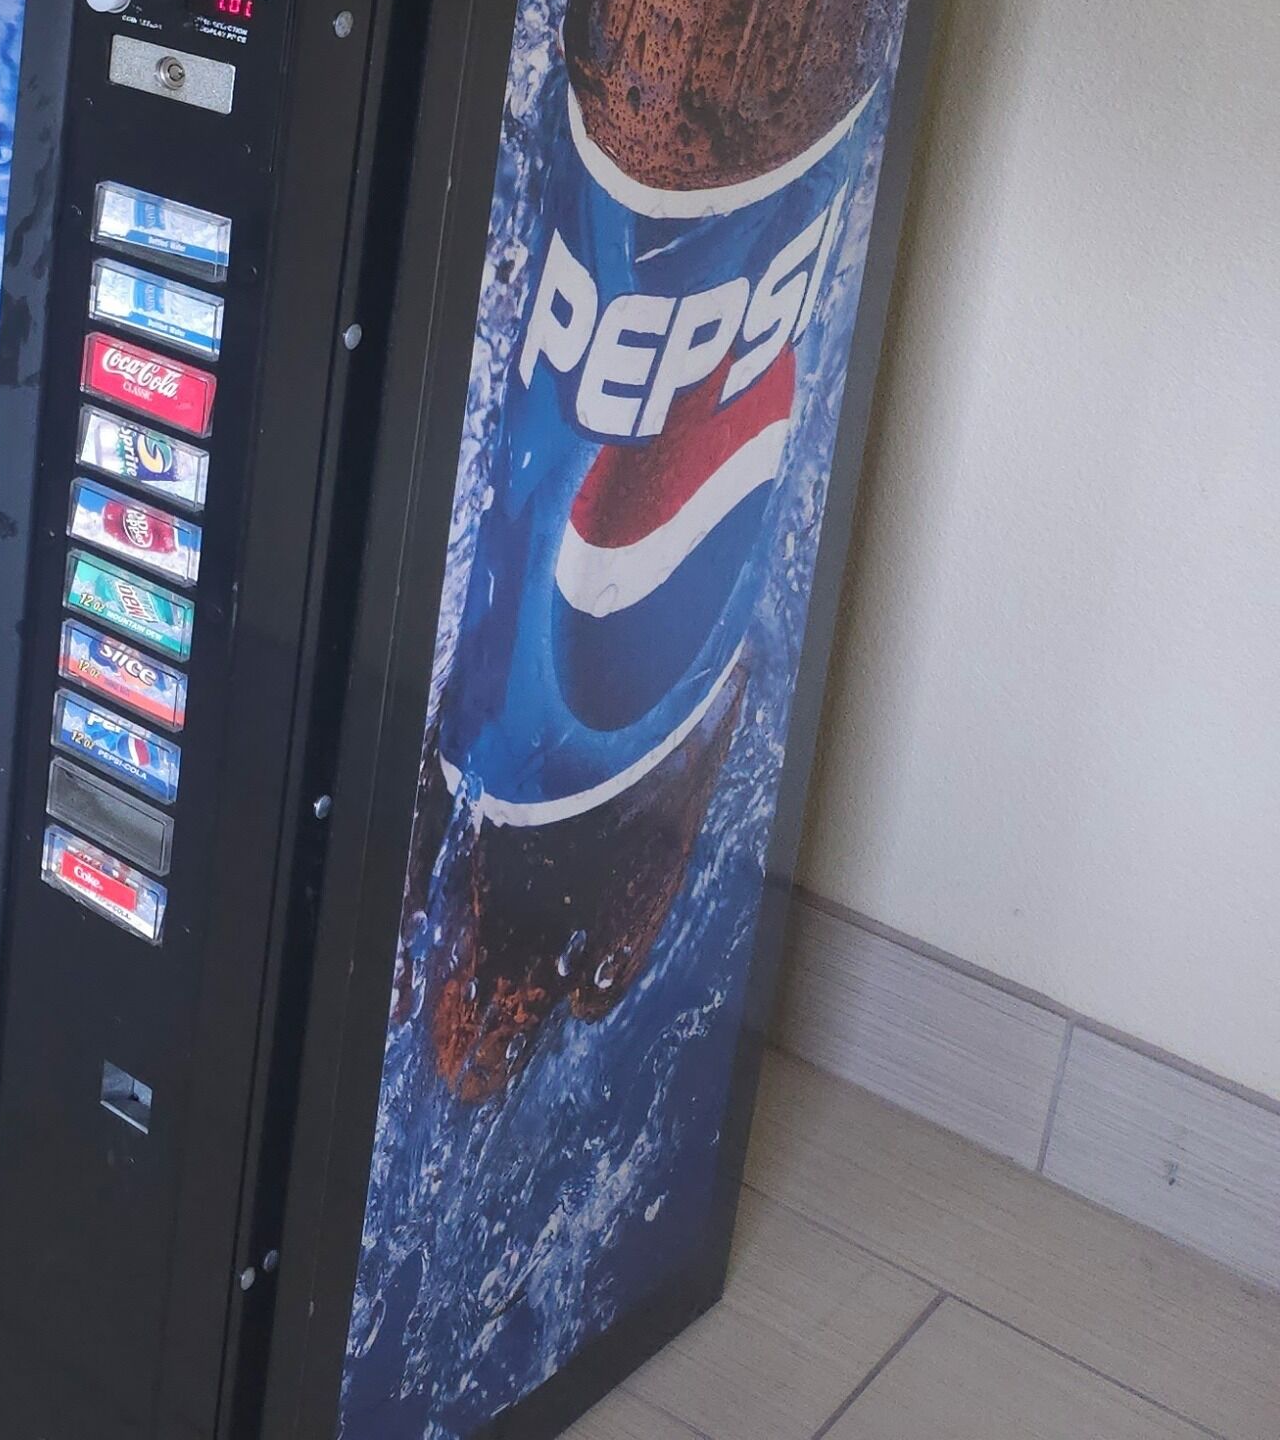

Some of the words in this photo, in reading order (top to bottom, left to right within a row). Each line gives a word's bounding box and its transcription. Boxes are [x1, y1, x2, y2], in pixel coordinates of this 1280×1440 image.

[518, 179, 848, 437] PEPSI
[119, 424, 138, 477] Sprite
[78, 592, 93, 608] 12
[106, 610, 145, 637] MOUNTAIN
[78, 659, 91, 673] 12
[71, 729, 84, 745] 12
[97, 749, 147, 780] PEPSI-COLA
[73, 864, 100, 887] Coke
